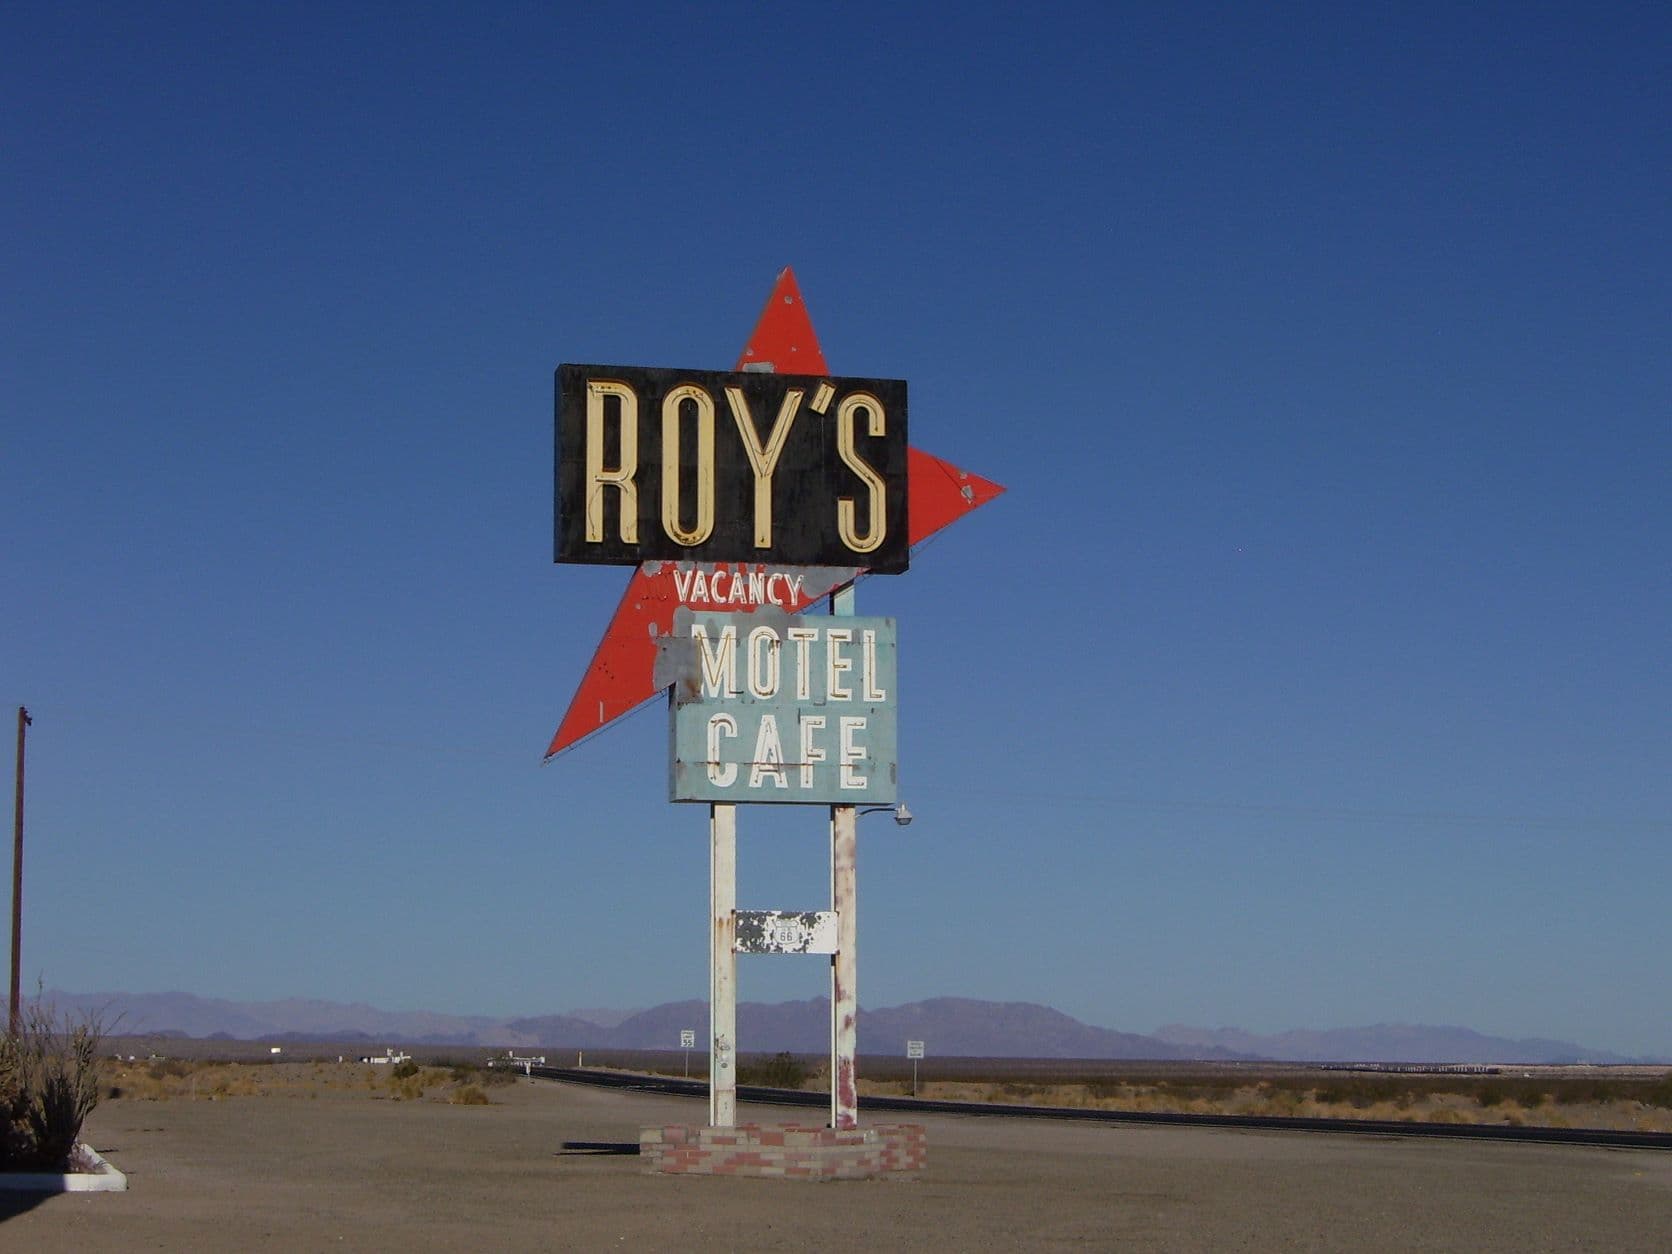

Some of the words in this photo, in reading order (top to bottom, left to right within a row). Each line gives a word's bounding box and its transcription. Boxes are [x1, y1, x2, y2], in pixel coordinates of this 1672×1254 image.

[585, 379, 887, 553] ROY'S
[673, 569, 804, 606] VACANCY
[692, 623, 886, 702] MOTEL
[706, 712, 868, 789] CAFE
[780, 931, 793, 942] 66
